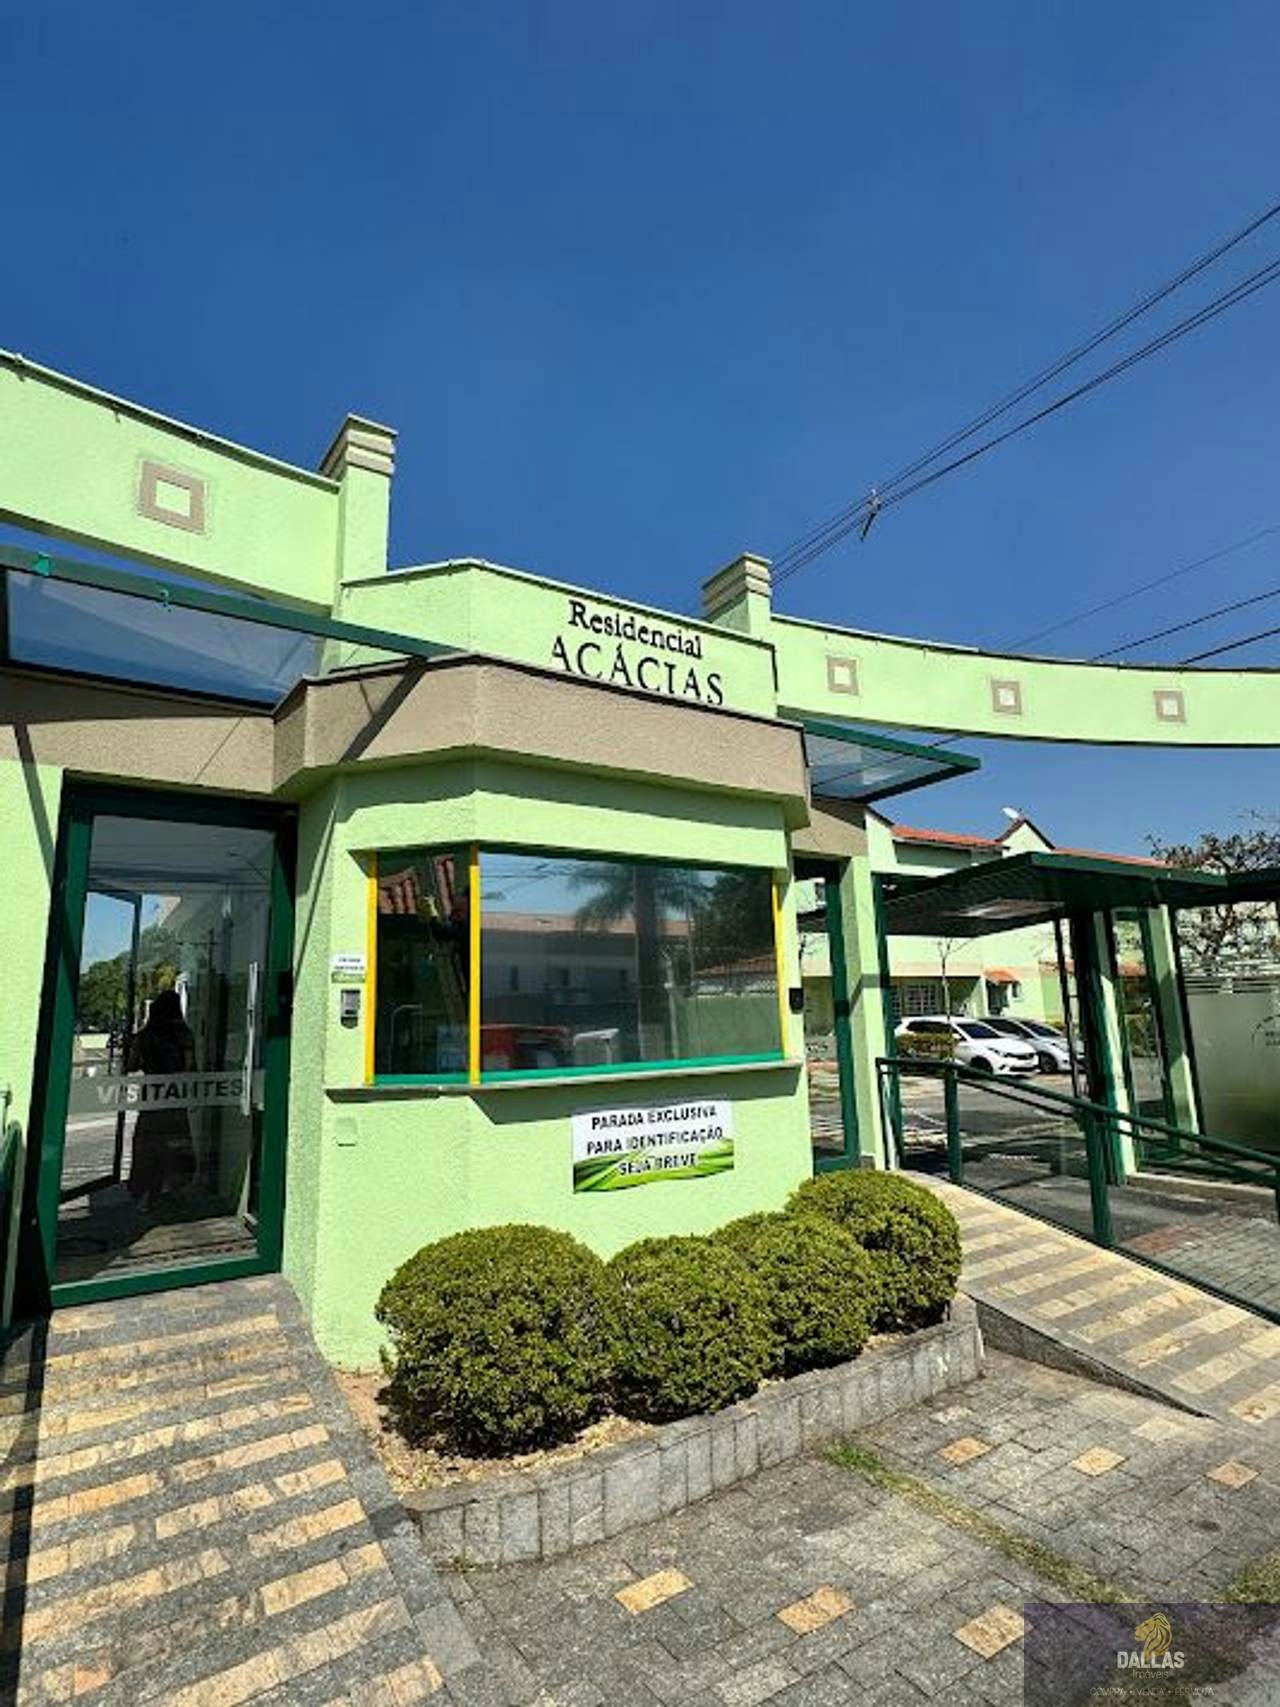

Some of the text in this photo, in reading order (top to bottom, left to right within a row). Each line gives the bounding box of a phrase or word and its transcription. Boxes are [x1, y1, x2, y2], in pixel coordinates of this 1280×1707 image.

[568, 600, 703, 659] Residencial
[552, 635, 723, 705] ACÁCIAS
[97, 1079, 243, 1104] VISITANTES
[592, 1105, 717, 1130] PARADA EXCLUSIVA
[587, 1125, 723, 1155] PARA IDENTIFICAÇÃO
[619, 1153, 697, 1175] SEJA BREVE
